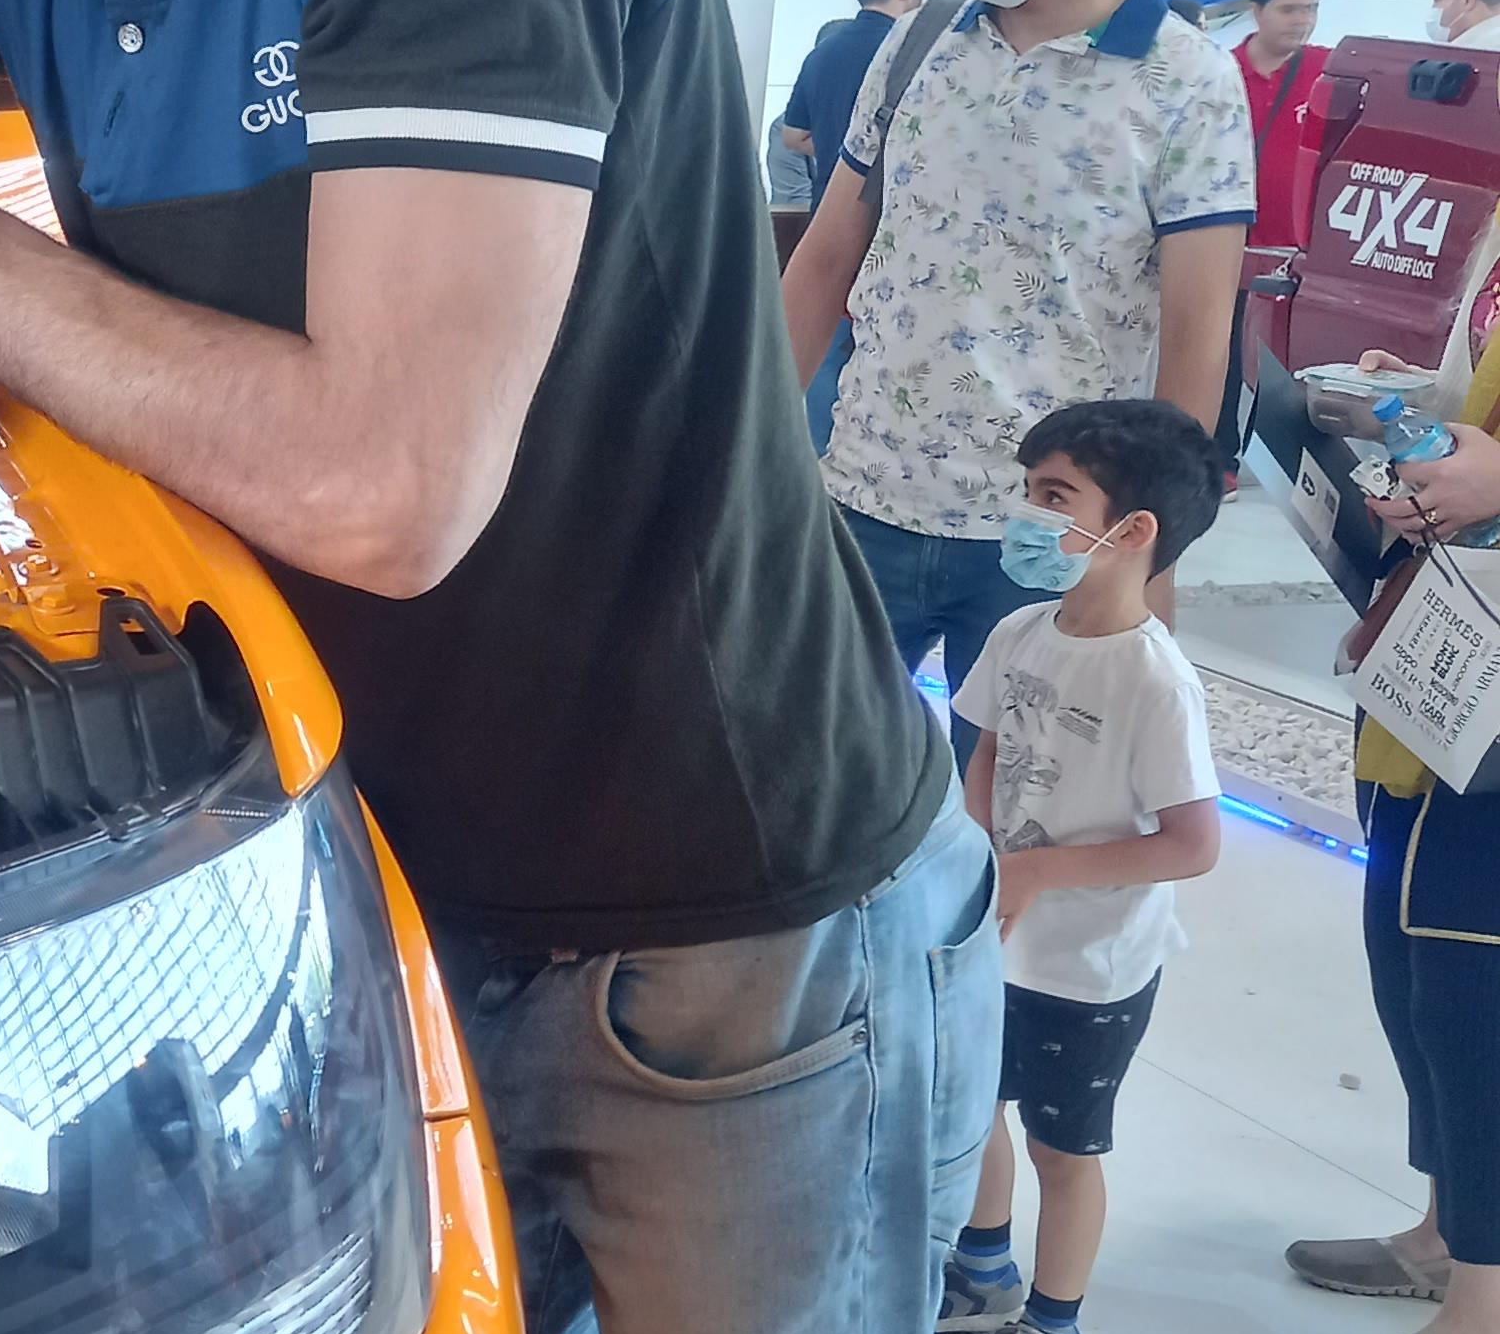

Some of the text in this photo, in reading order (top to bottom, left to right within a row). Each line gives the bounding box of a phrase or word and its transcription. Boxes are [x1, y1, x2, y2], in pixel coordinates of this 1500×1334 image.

[240, 89, 304, 134] GUC
[1350, 162, 1405, 187] OFF ROAD
[1328, 172, 1454, 266] 4X4
[1371, 251, 1436, 280] AUTO DIFF LOCK
[1429, 638, 1452, 673] MONT
[1437, 644, 1460, 680] BLANC
[1370, 672, 1413, 717] BOSS
[1444, 694, 1479, 747] GIORGIO
